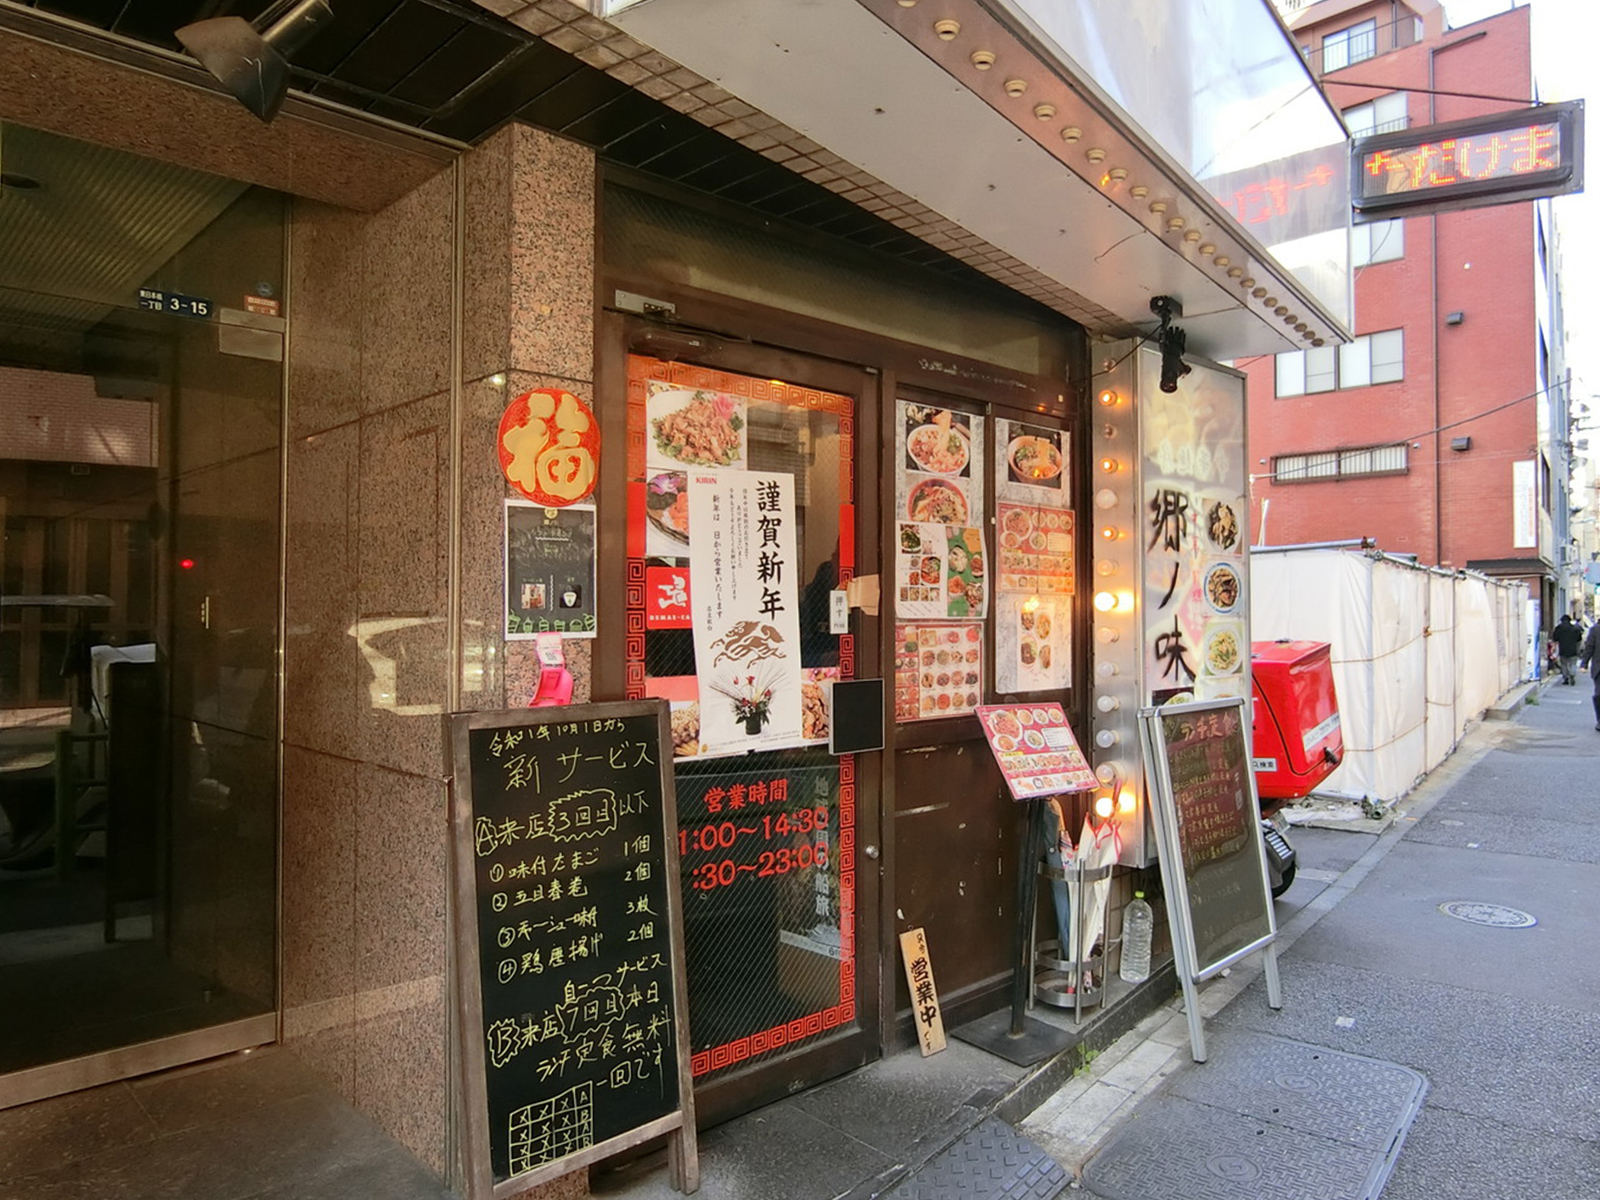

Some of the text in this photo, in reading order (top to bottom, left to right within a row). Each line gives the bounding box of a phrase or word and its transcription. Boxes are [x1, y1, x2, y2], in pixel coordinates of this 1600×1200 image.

[170, 298, 208, 315] 3-15
[502, 392, 595, 500] 福
[695, 476, 717, 485] KIRIN
[755, 480, 785, 621] 謹賀新年
[1147, 489, 1196, 682] 郷ノ味
[704, 778, 788, 813] 営業時間
